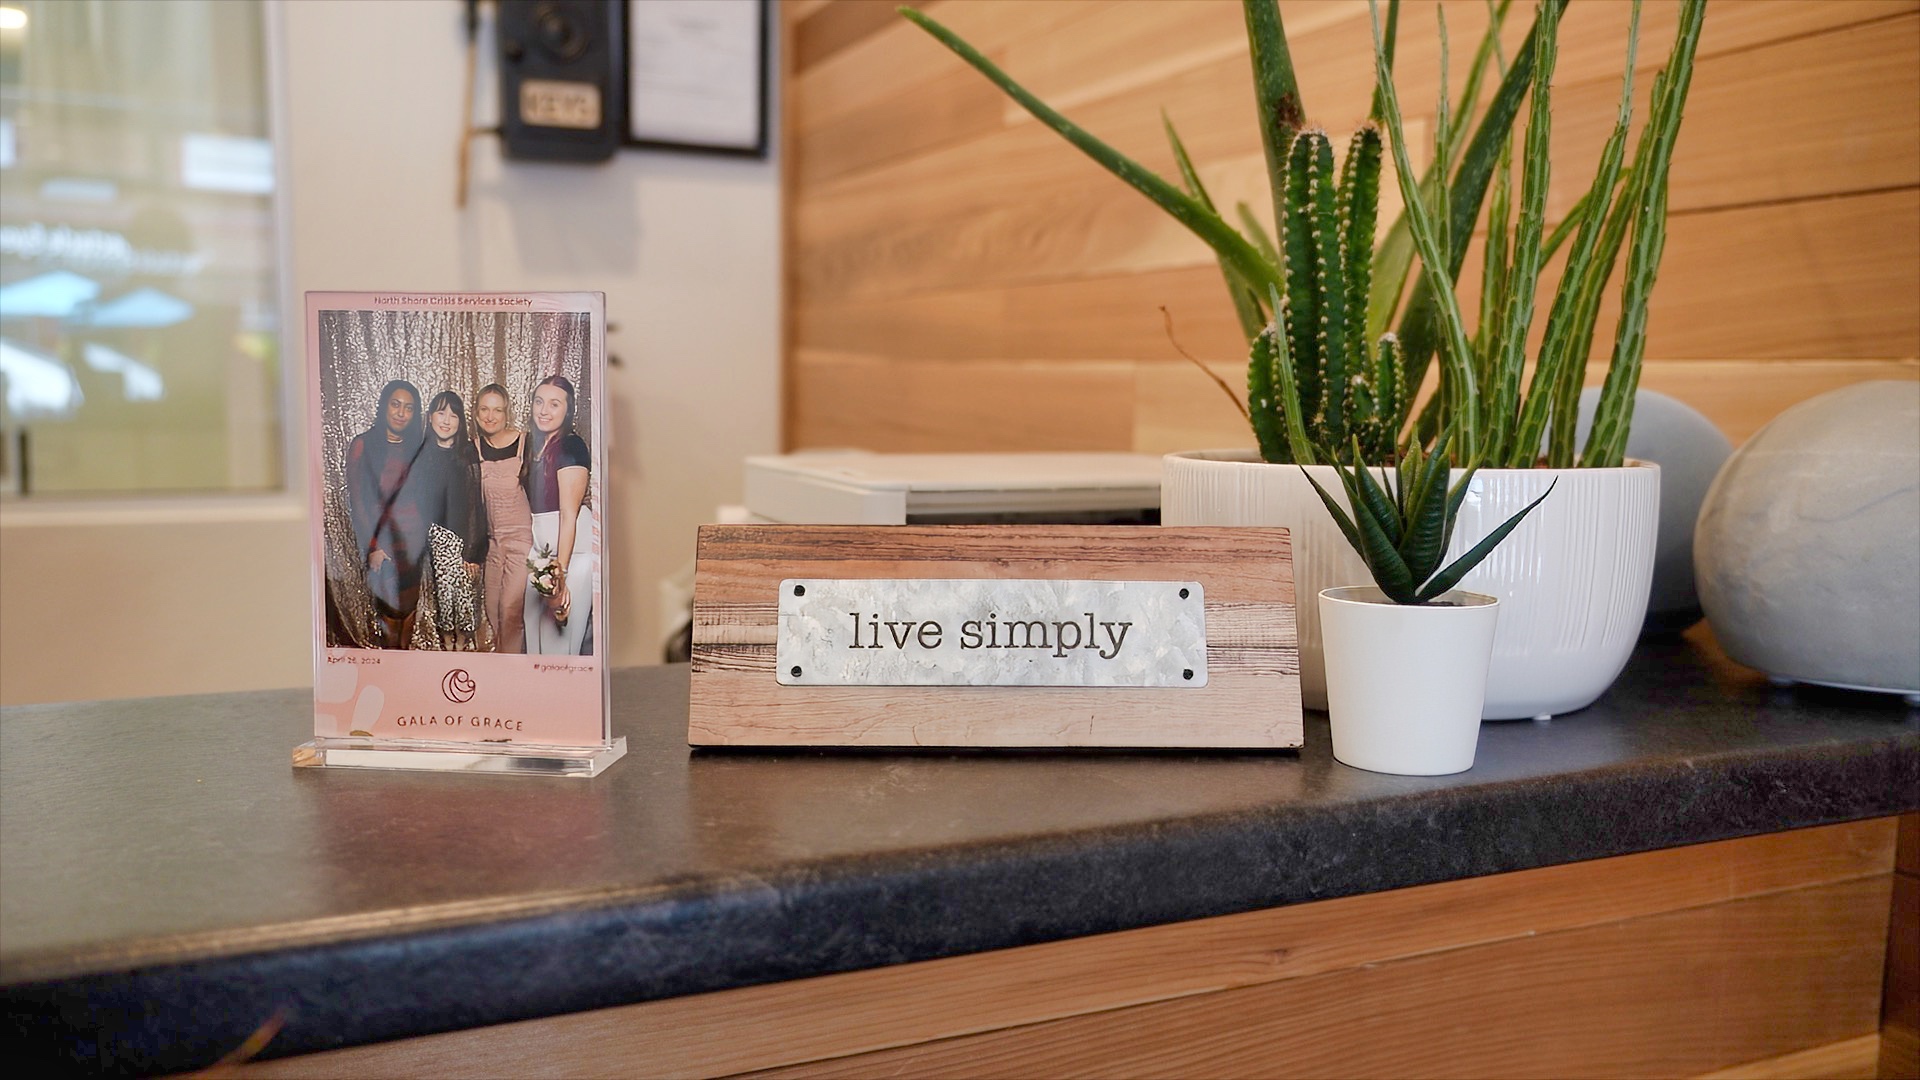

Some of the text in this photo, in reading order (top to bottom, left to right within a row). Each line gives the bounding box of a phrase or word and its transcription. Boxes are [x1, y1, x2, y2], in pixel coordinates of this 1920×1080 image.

[374, 296, 533, 308] North Shore Crisis Services Society
[847, 612, 1133, 660] live simply
[361, 657, 381, 665] 2024
[533, 663, 594, 673] #galaofgrace
[396, 715, 523, 732] GALA OF GRACE
